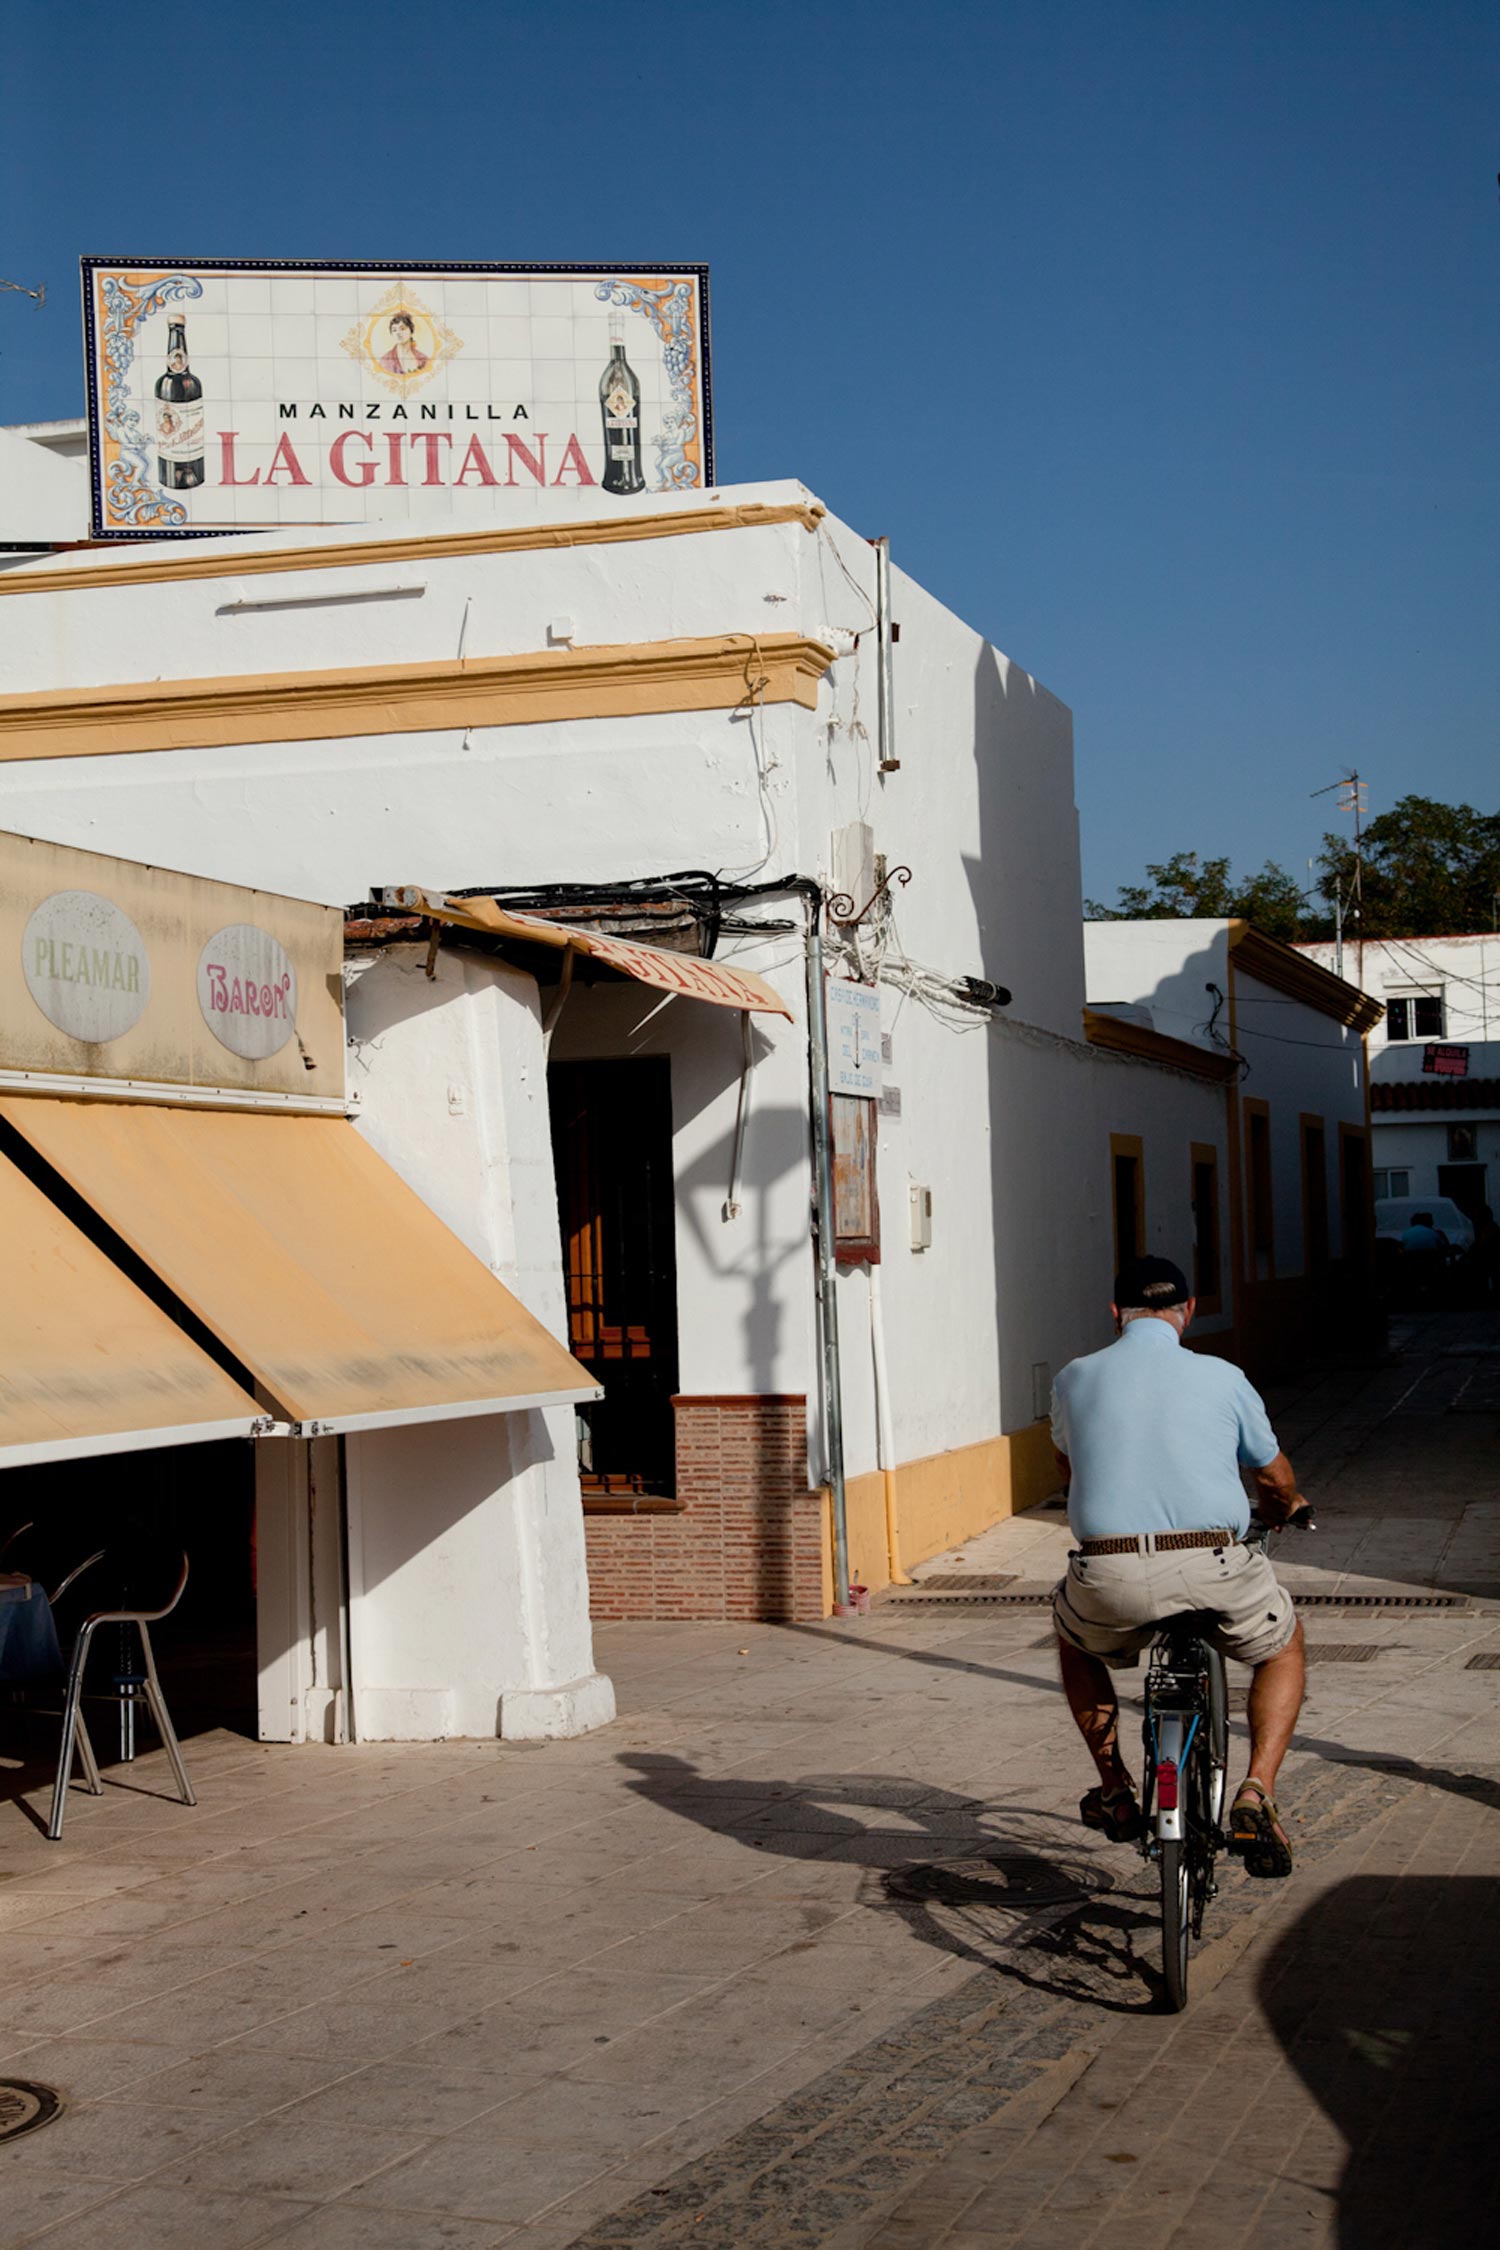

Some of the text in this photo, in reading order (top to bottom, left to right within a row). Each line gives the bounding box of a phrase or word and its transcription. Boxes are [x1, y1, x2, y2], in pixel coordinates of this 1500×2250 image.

[279, 402, 530, 420] MANZANILLA
[216, 431, 313, 487] LA
[329, 429, 600, 488] GITANA
[35, 937, 140, 994] PLEAMAR
